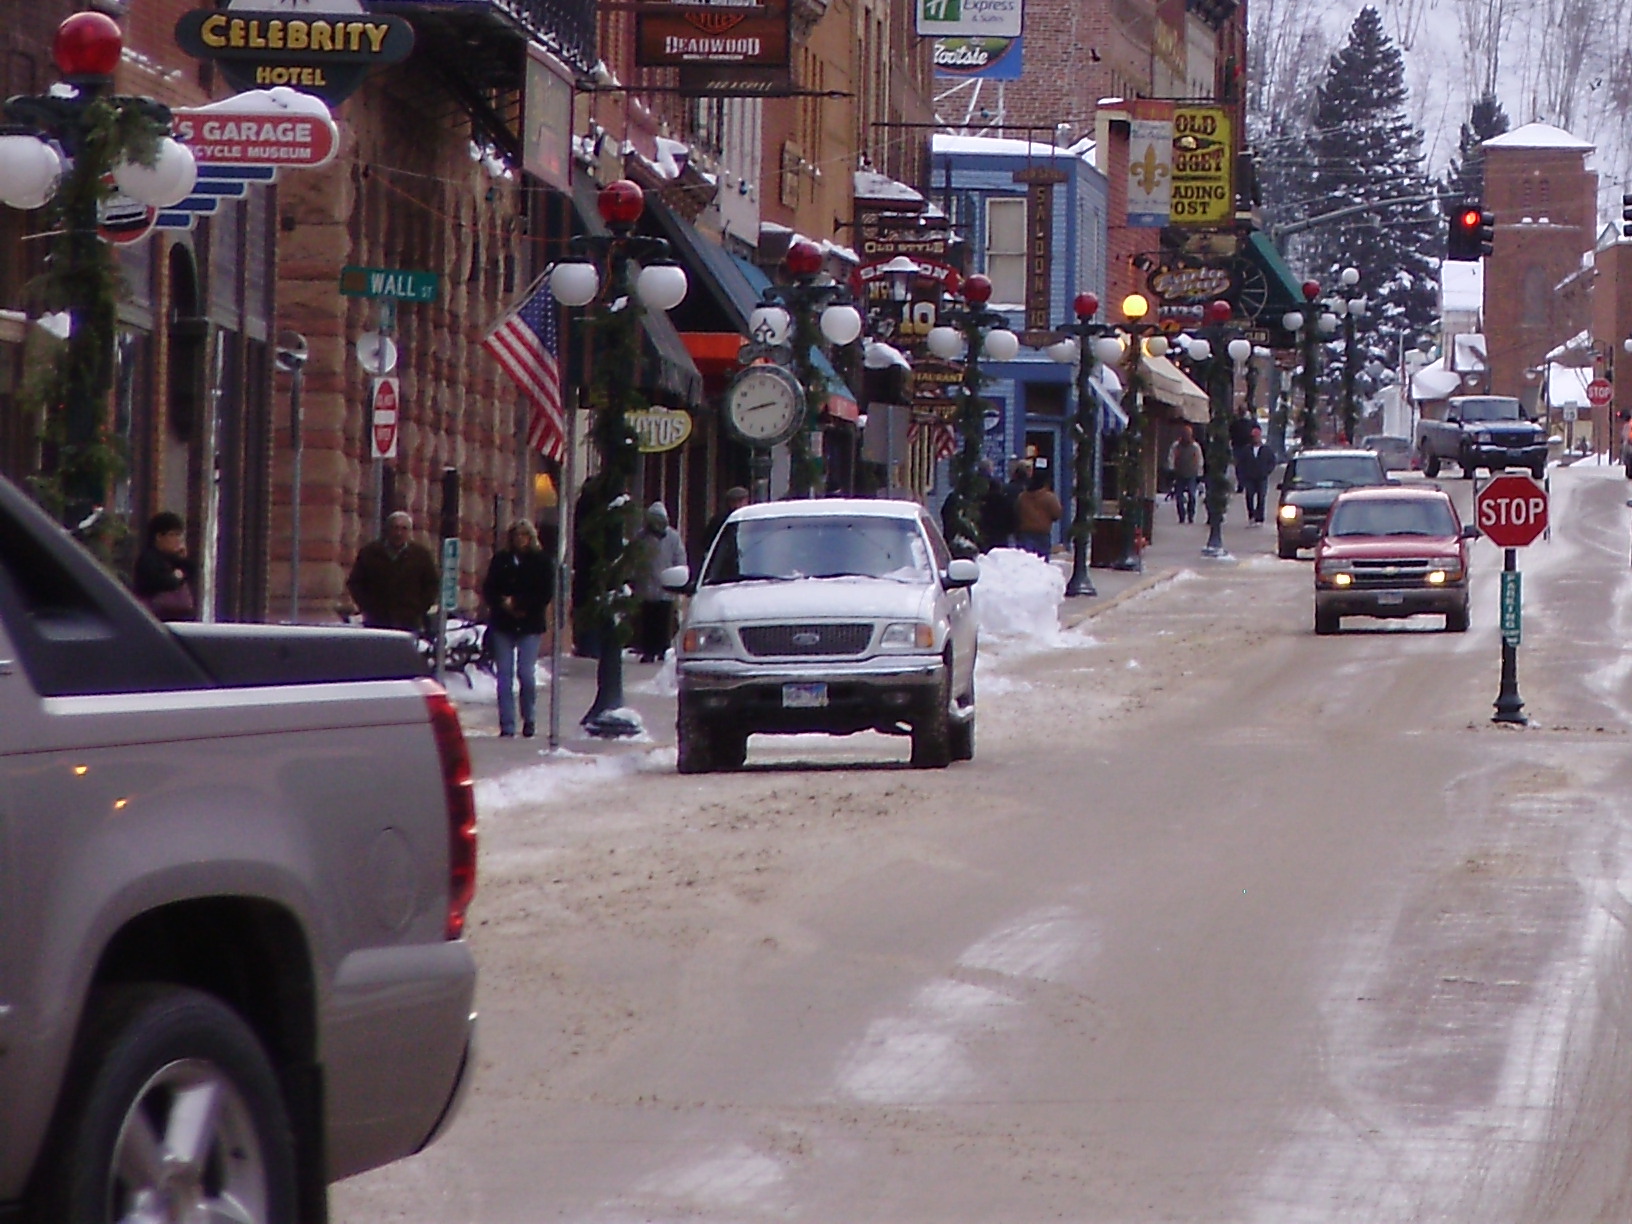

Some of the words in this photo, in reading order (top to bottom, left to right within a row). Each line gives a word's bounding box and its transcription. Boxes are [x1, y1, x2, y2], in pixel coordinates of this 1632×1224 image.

[201, 13, 388, 53] CELEBRITY
[664, 35, 761, 56] DEADWOOD
[256, 65, 326, 86] HOTEL
[202, 121, 312, 143] GARAGE
[1174, 113, 1217, 136] OLD
[247, 146, 312, 160] MUSEUM
[864, 241, 895, 254] OLD
[897, 241, 945, 254] STYLE
[1035, 187, 1046, 292] SALOON
[860, 262, 949, 280] SAON
[370, 273, 416, 298] WALL
[900, 301, 936, 335] 10
[1588, 386, 1612, 398] STOP
[1481, 497, 1545, 526] STOP
